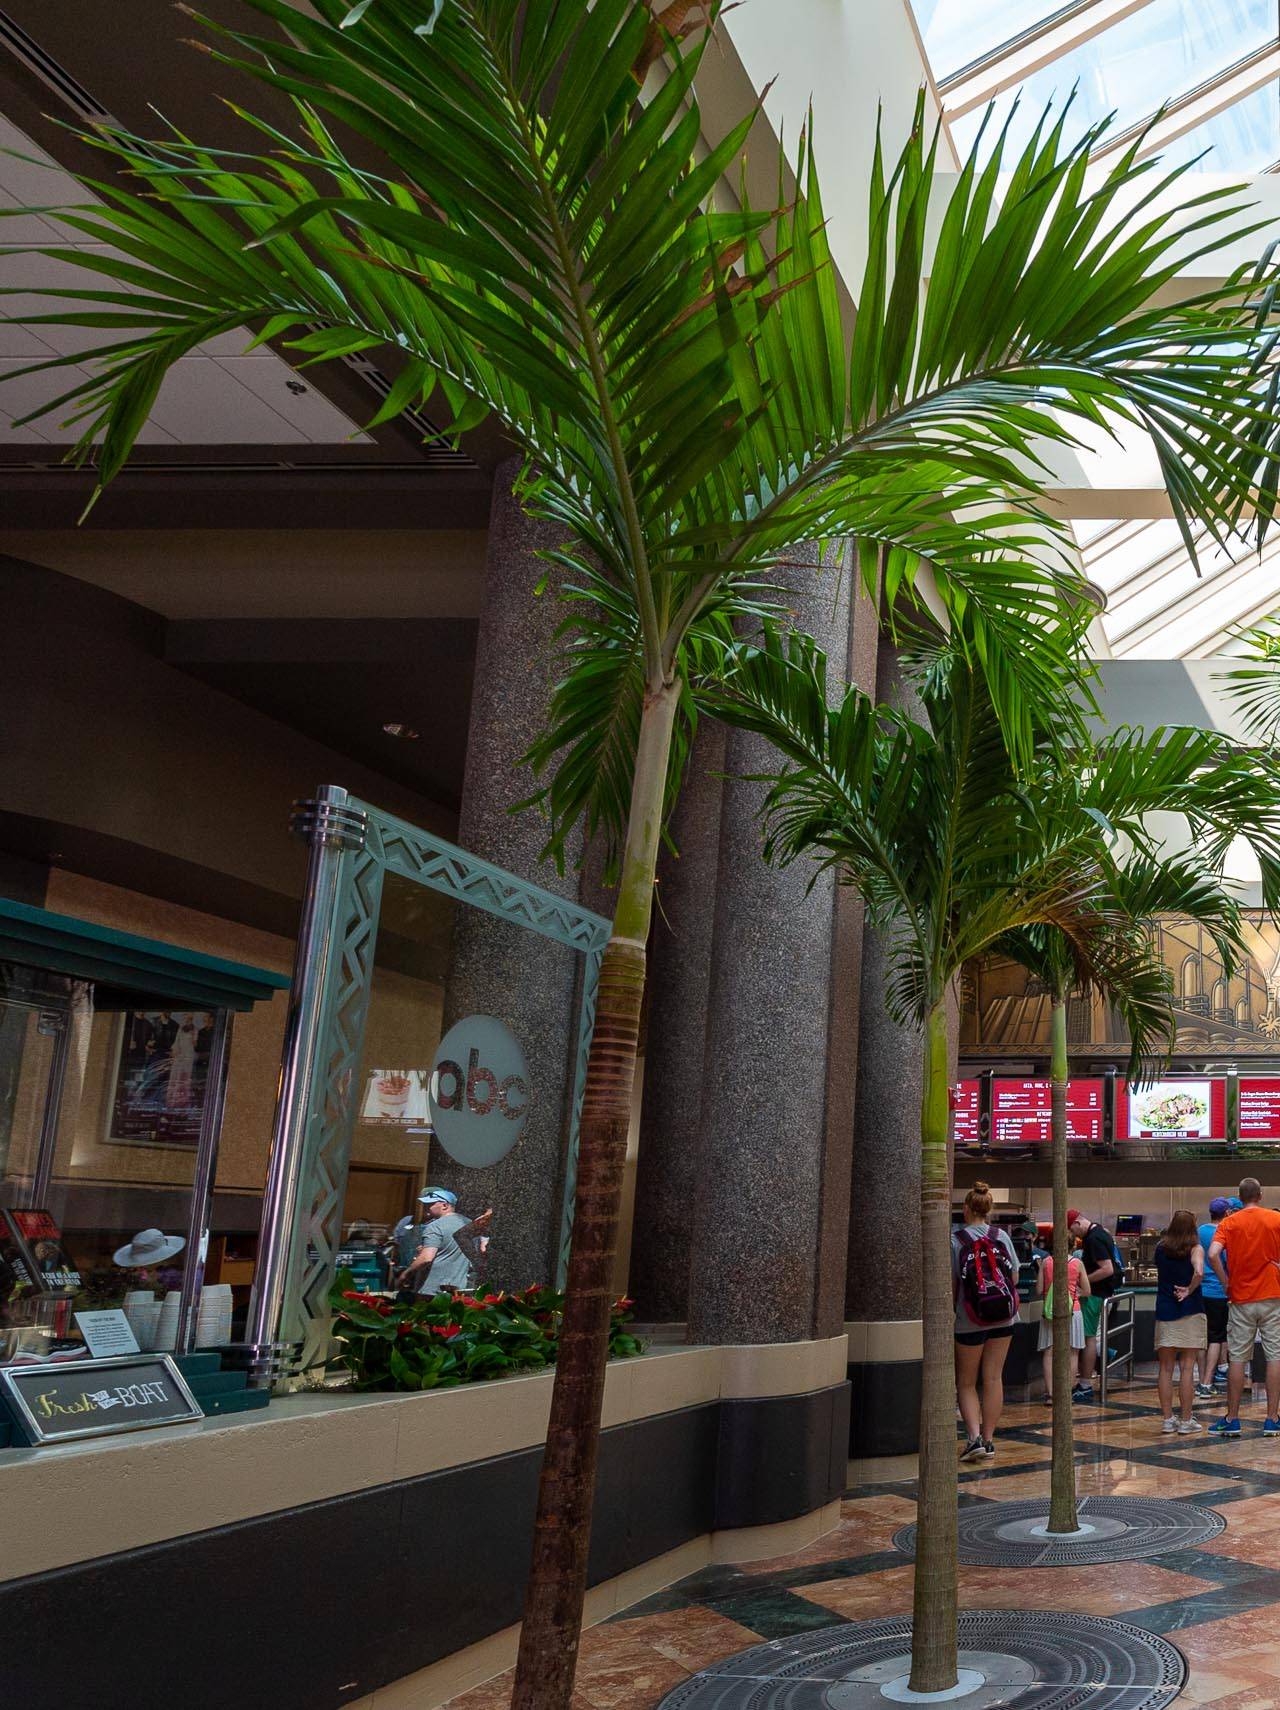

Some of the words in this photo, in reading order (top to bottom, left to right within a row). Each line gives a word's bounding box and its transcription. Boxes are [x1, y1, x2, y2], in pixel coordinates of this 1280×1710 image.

[436, 1048, 527, 1121] abc
[35, 1389, 98, 1419] Fresh
[113, 1381, 169, 1408] BOAT
